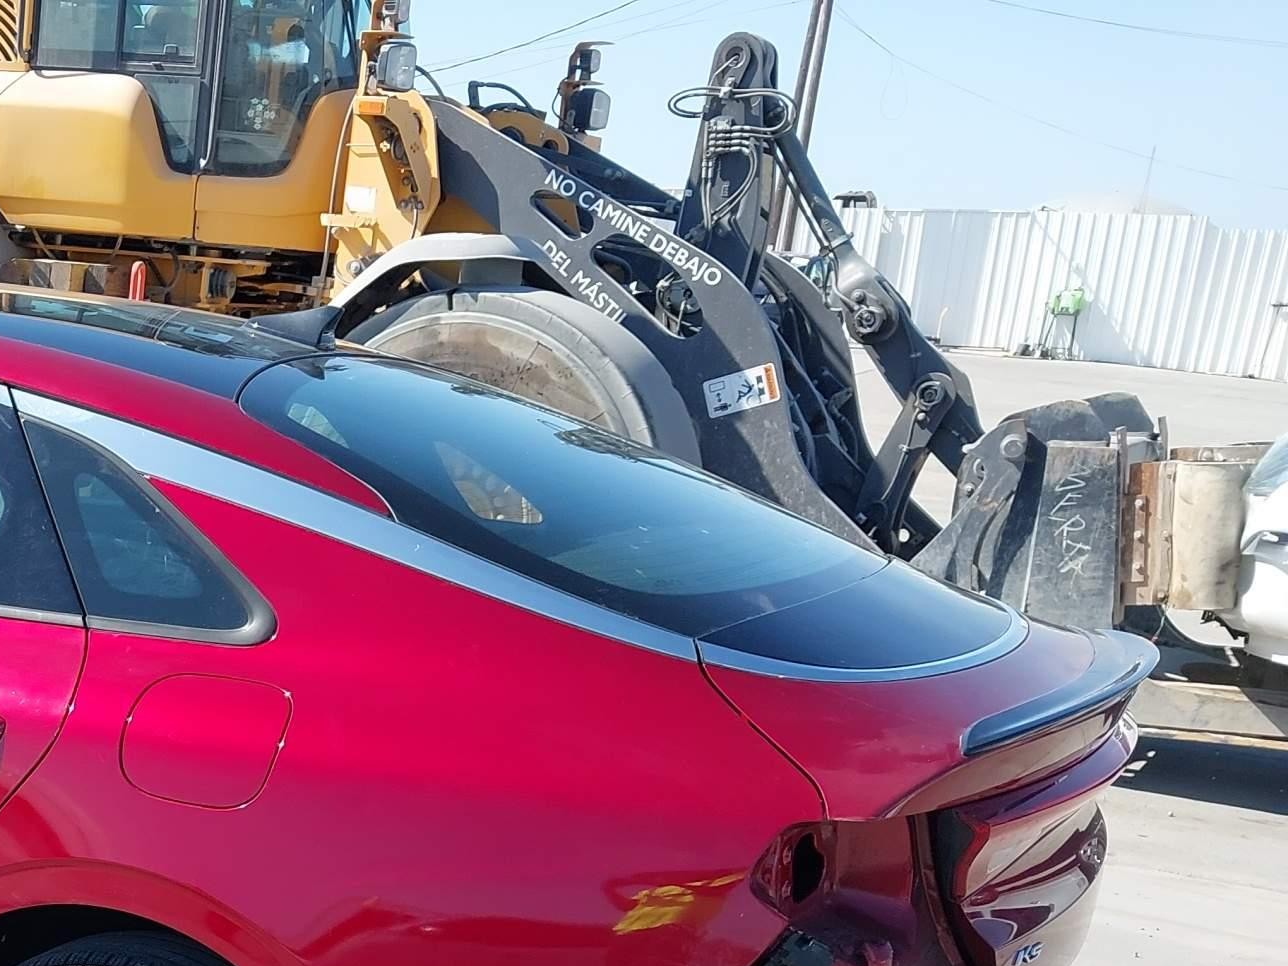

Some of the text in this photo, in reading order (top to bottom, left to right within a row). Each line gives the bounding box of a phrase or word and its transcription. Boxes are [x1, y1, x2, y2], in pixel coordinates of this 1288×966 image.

[542, 239, 572, 277] DEL
[544, 168, 722, 286] NO CAMINE DEBAJO
